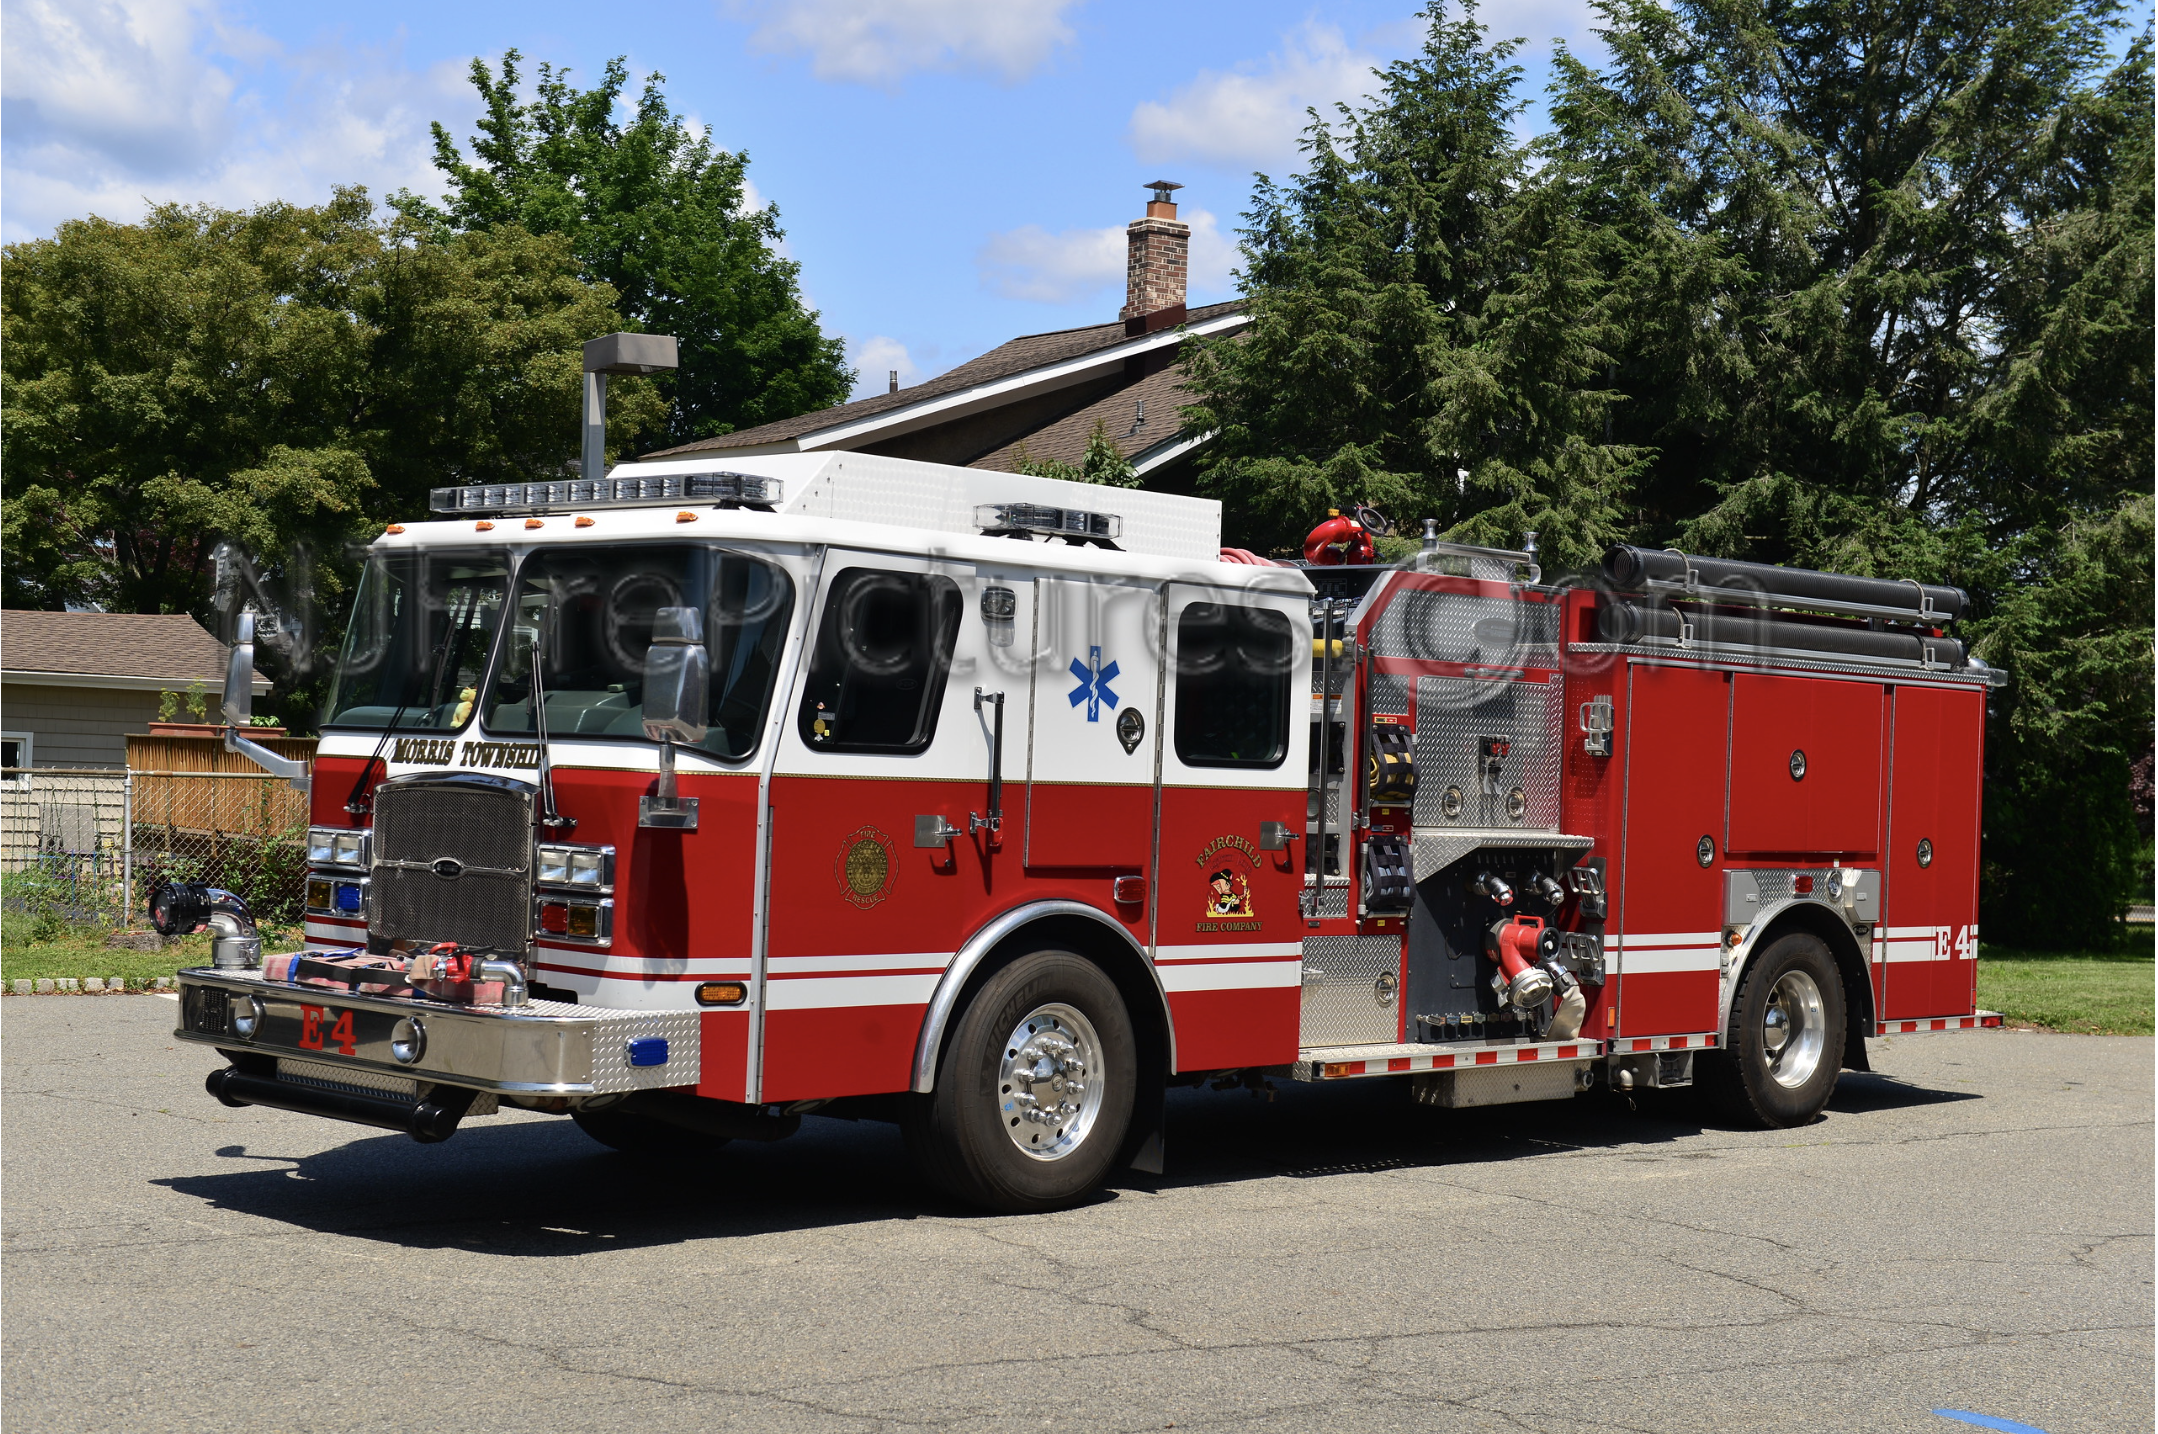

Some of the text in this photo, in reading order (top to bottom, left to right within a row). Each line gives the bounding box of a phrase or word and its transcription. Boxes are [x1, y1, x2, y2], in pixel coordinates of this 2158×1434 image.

[390, 737, 457, 767] MORRIS
[860, 830, 876, 839] FIRE
[1195, 834, 1262, 869] FAIRCHILD
[852, 893, 879, 904] RESCUE
[1195, 921, 1263, 933] FIRE COMPANY
[985, 975, 1051, 1063] MICHELIN
